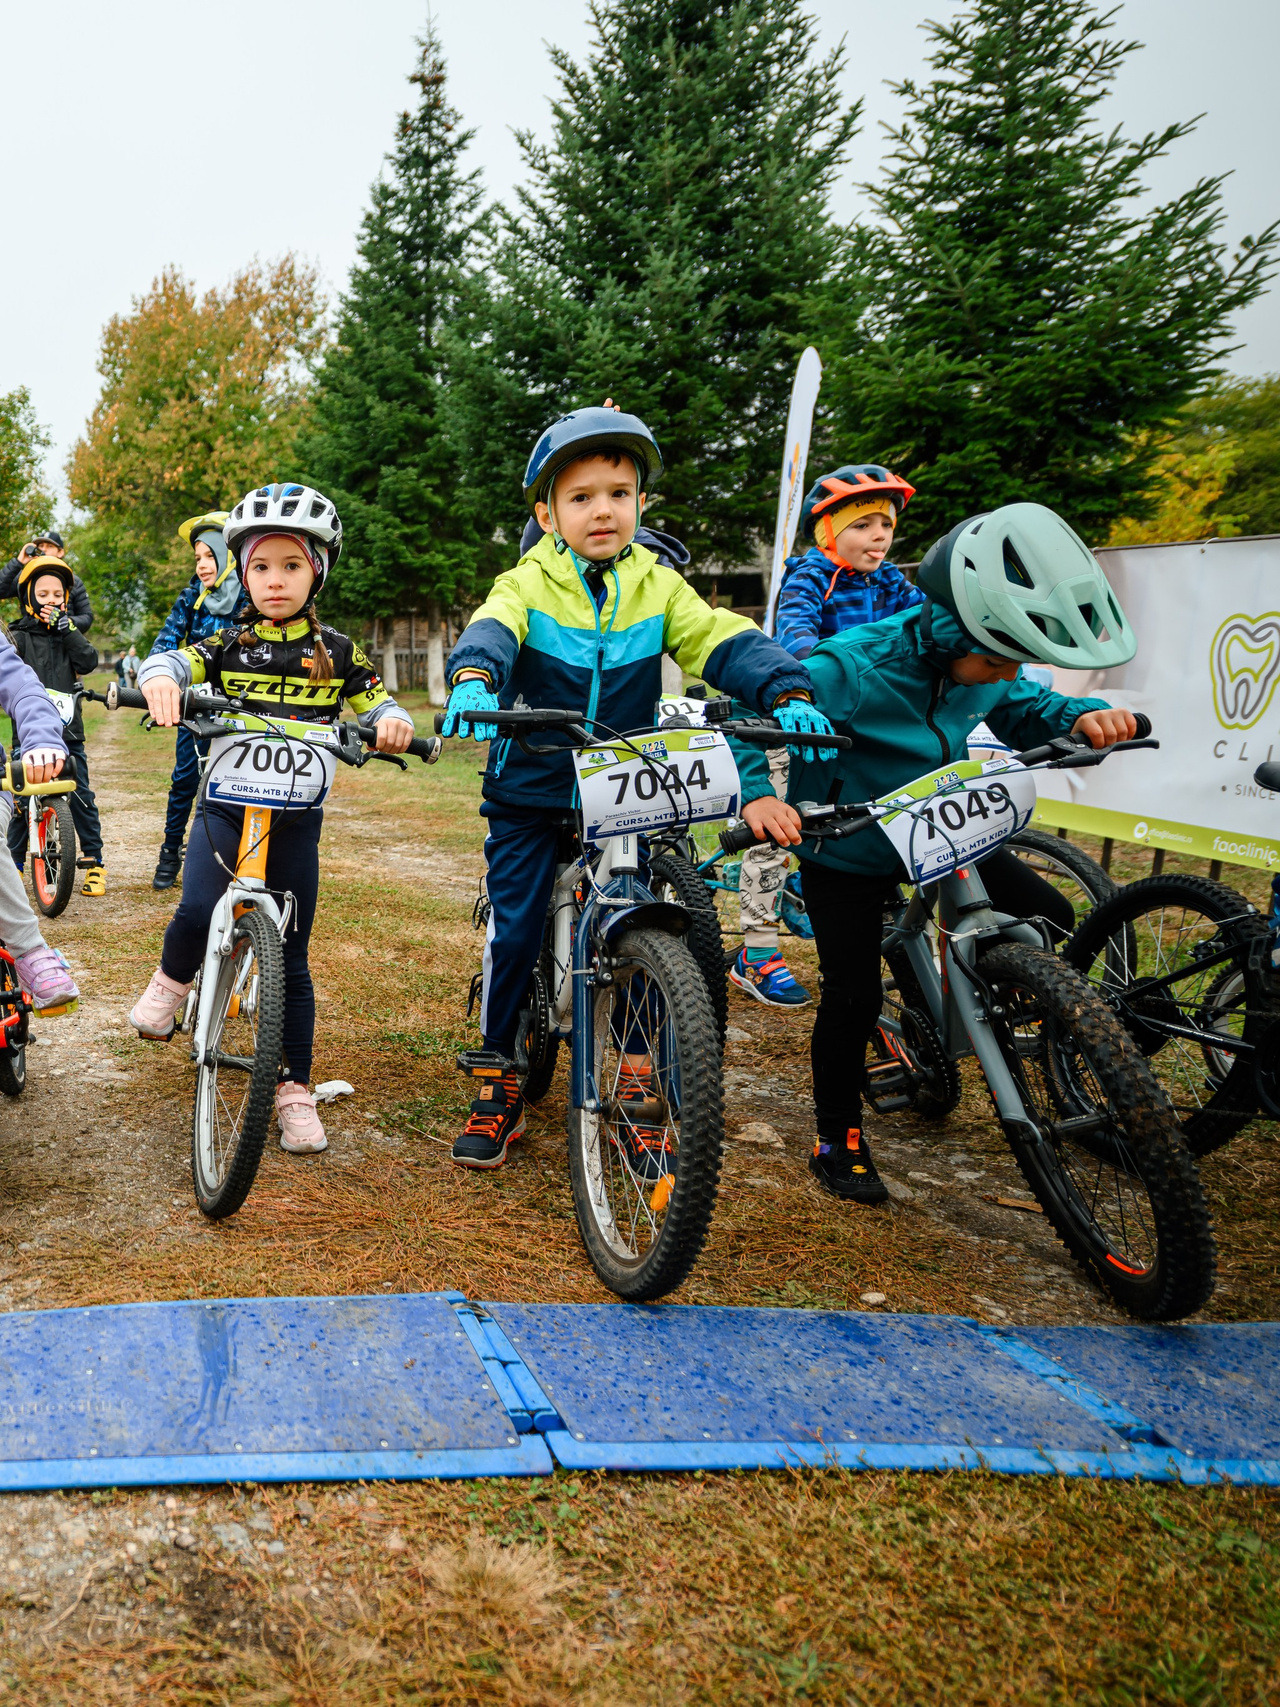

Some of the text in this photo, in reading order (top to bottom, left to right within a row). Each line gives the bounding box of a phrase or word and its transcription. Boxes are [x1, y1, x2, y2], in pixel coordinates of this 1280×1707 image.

[226, 678, 340, 699] SCOTT
[660, 702, 699, 717] 01
[233, 741, 313, 777] 7002
[231, 783, 303, 799] CURSA MTB KDS
[608, 759, 710, 805] 7044
[1234, 784, 1276, 800] SINCE
[615, 807, 705, 827] CURSA MTB KIDS
[910, 782, 1011, 840] 7049
[936, 827, 1009, 863] CURSA MTB KIDS
